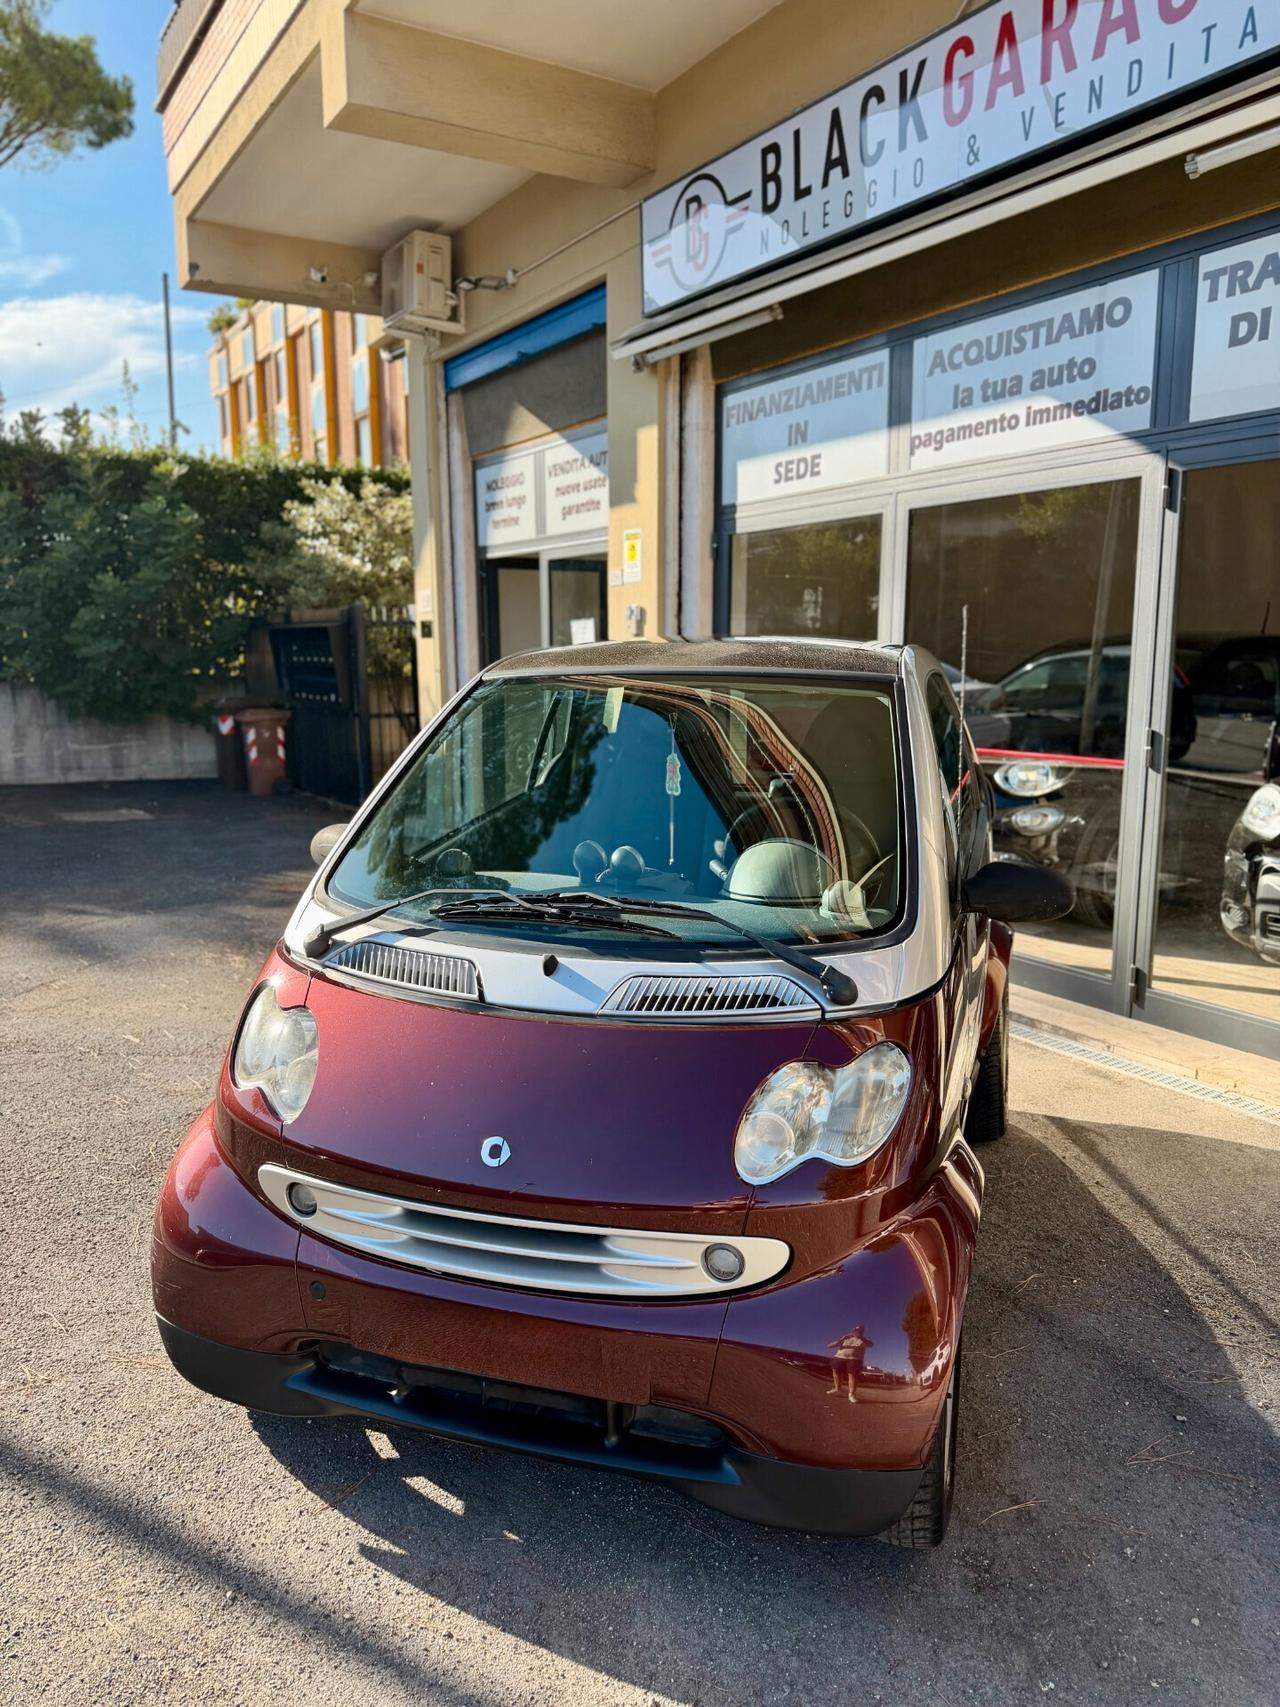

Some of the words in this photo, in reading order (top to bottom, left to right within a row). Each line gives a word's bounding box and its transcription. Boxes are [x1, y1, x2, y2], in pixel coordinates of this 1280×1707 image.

[760, 157, 924, 255] NOLEGGIO
[966, 134, 981, 166] &
[1021, 6, 1258, 141] VENDITA
[1203, 252, 1280, 303] TRA
[927, 296, 1132, 378] ACQUISTIAMO
[1228, 306, 1272, 349] DI
[725, 362, 885, 428] FINANZIAMENTI
[953, 384, 974, 410] la
[980, 374, 1023, 402] tua
[1029, 357, 1097, 392] auto
[787, 420, 809, 447] IN
[909, 412, 1020, 456] pagamento
[1025, 385, 1151, 427] immediato
[485, 472, 525, 493] NOLEGGIO
[547, 455, 586, 478] VENDITA
[773, 453, 822, 485] SEDE
